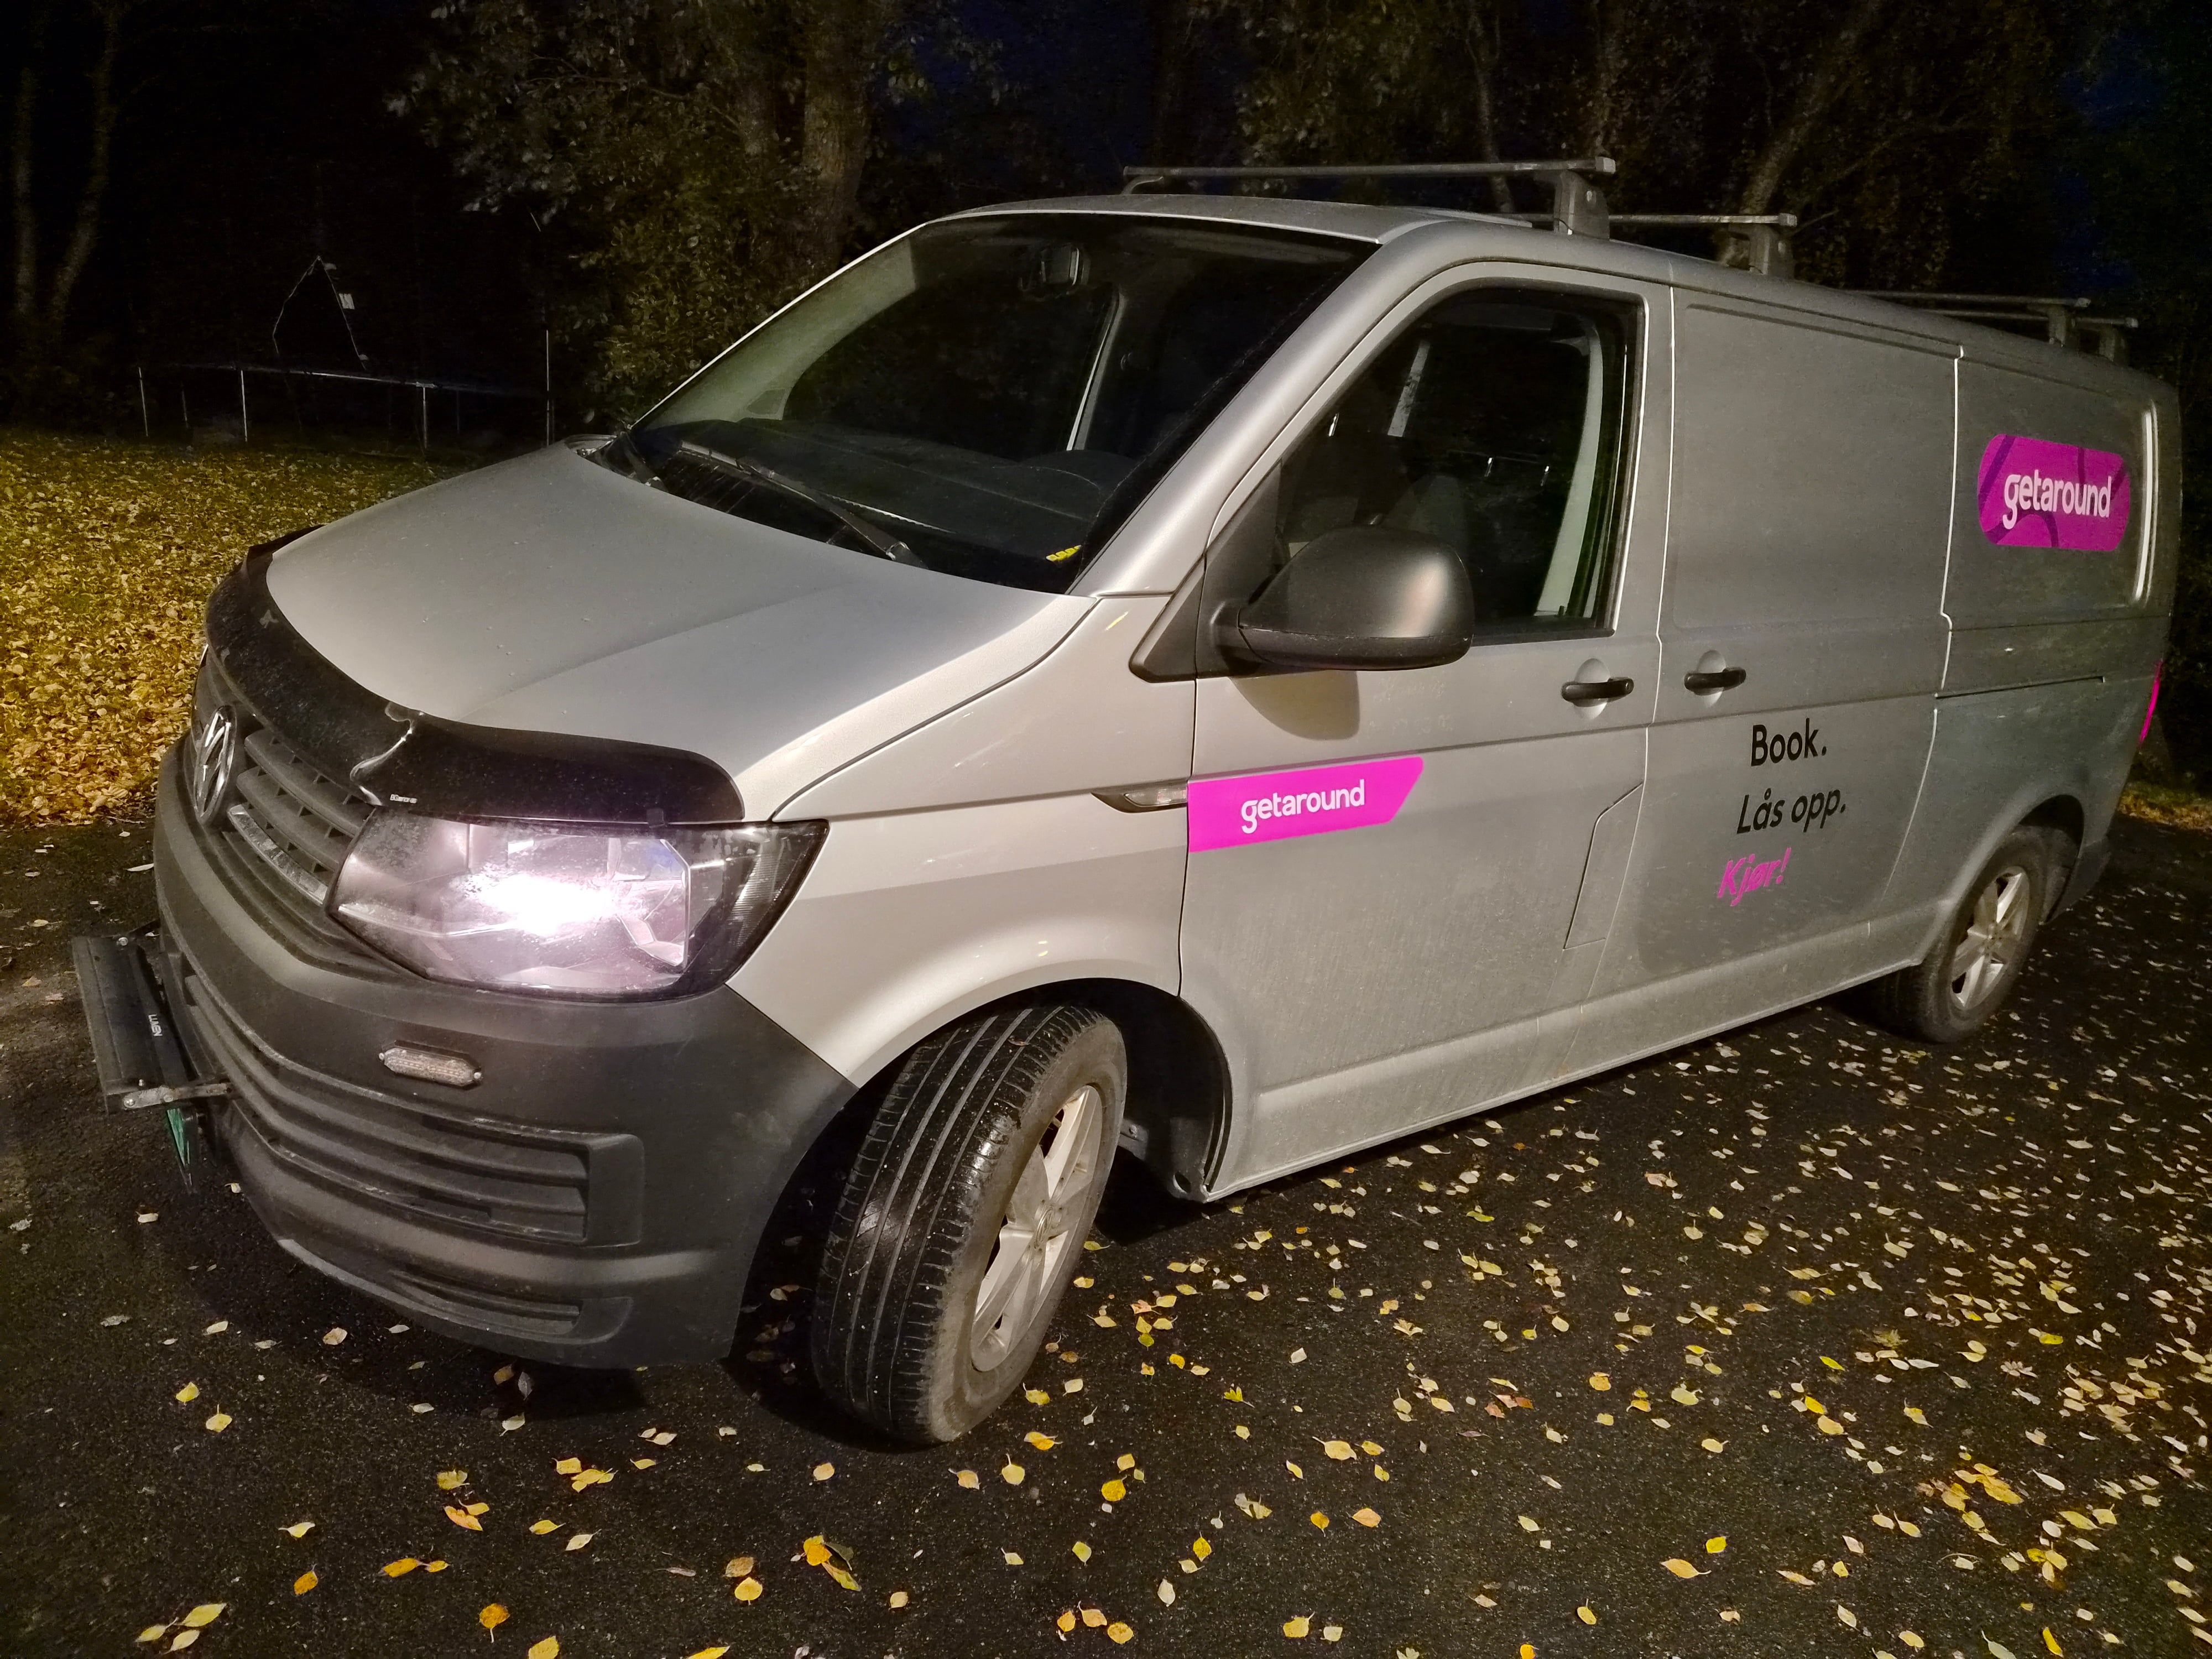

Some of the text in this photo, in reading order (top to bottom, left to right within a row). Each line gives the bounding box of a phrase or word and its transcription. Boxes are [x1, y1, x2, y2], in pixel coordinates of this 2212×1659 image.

[2002, 469, 2111, 530] getaround
[1751, 718, 1827, 766] Book.
[1241, 779, 1365, 834] getaround
[1736, 788, 1846, 834] Lås opp.
[1717, 847, 1792, 907] Kjør!
